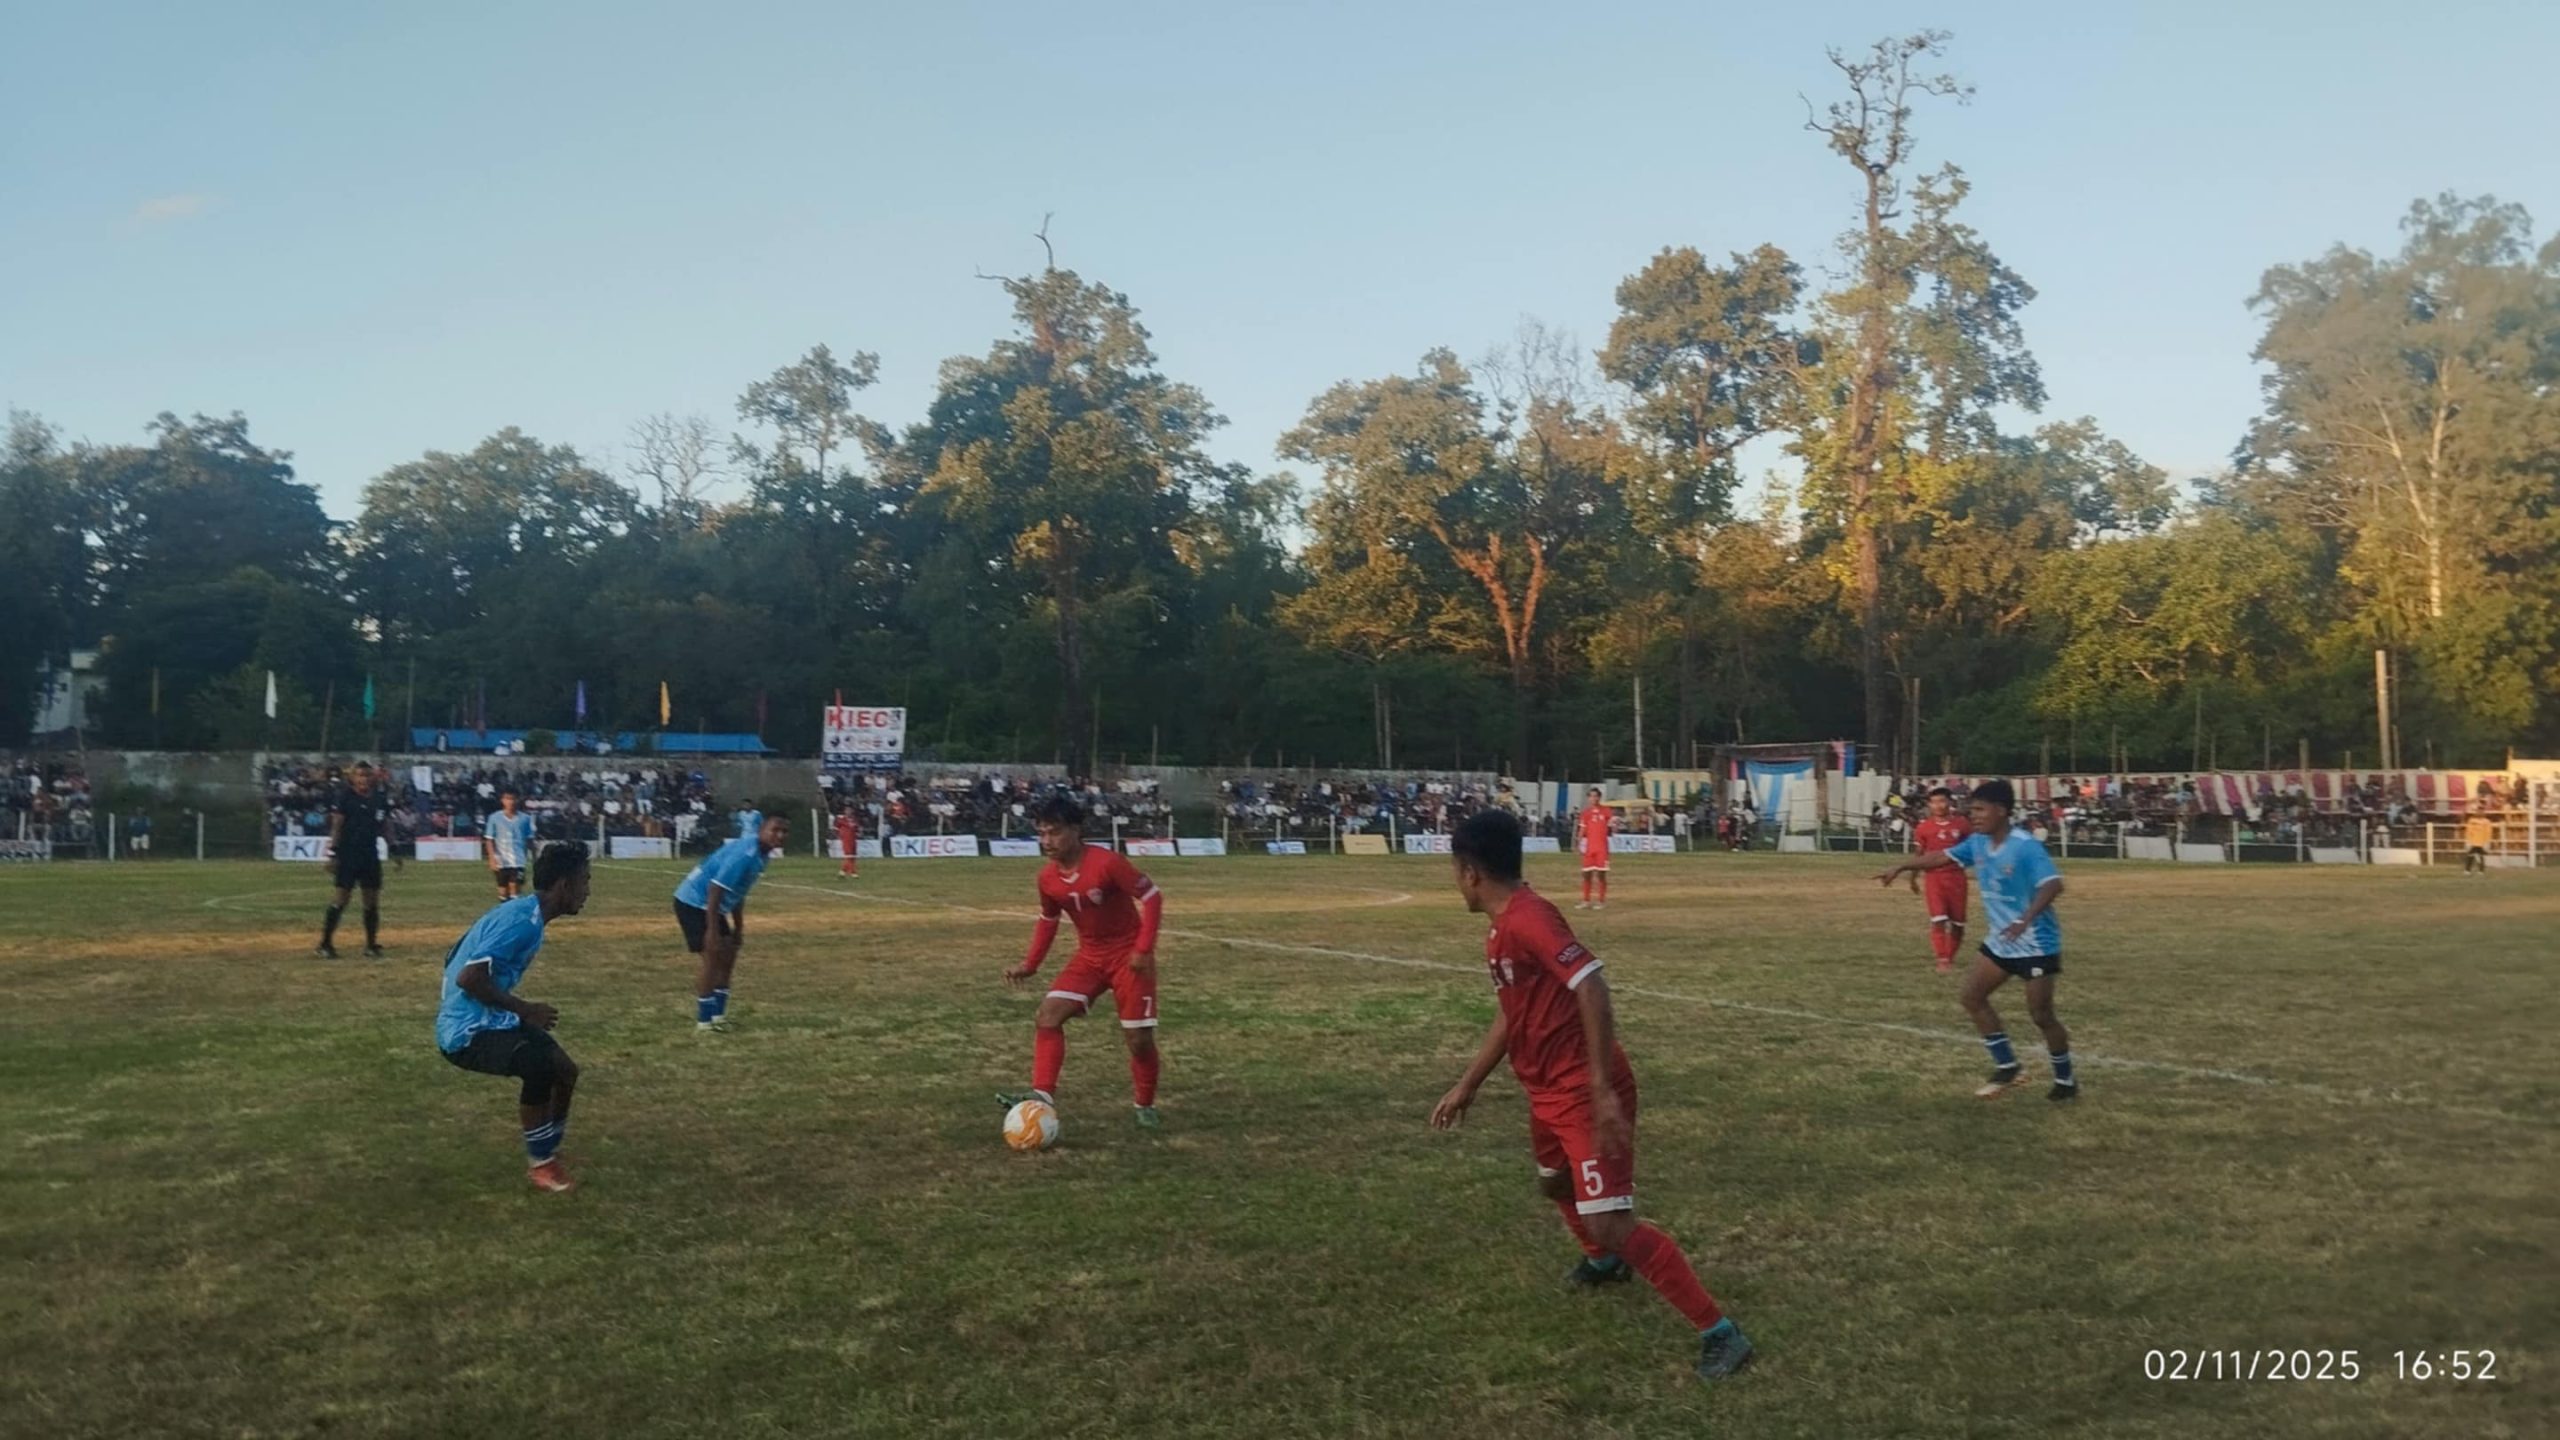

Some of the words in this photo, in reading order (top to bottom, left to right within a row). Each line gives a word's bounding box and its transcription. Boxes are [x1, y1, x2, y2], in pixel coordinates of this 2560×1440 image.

[827, 709, 889, 729] KIEC
[905, 838, 957, 855] KIEC
[1067, 891, 1082, 912] 7
[1141, 995, 1152, 1017] 7
[1581, 1159, 1604, 1197] 5
